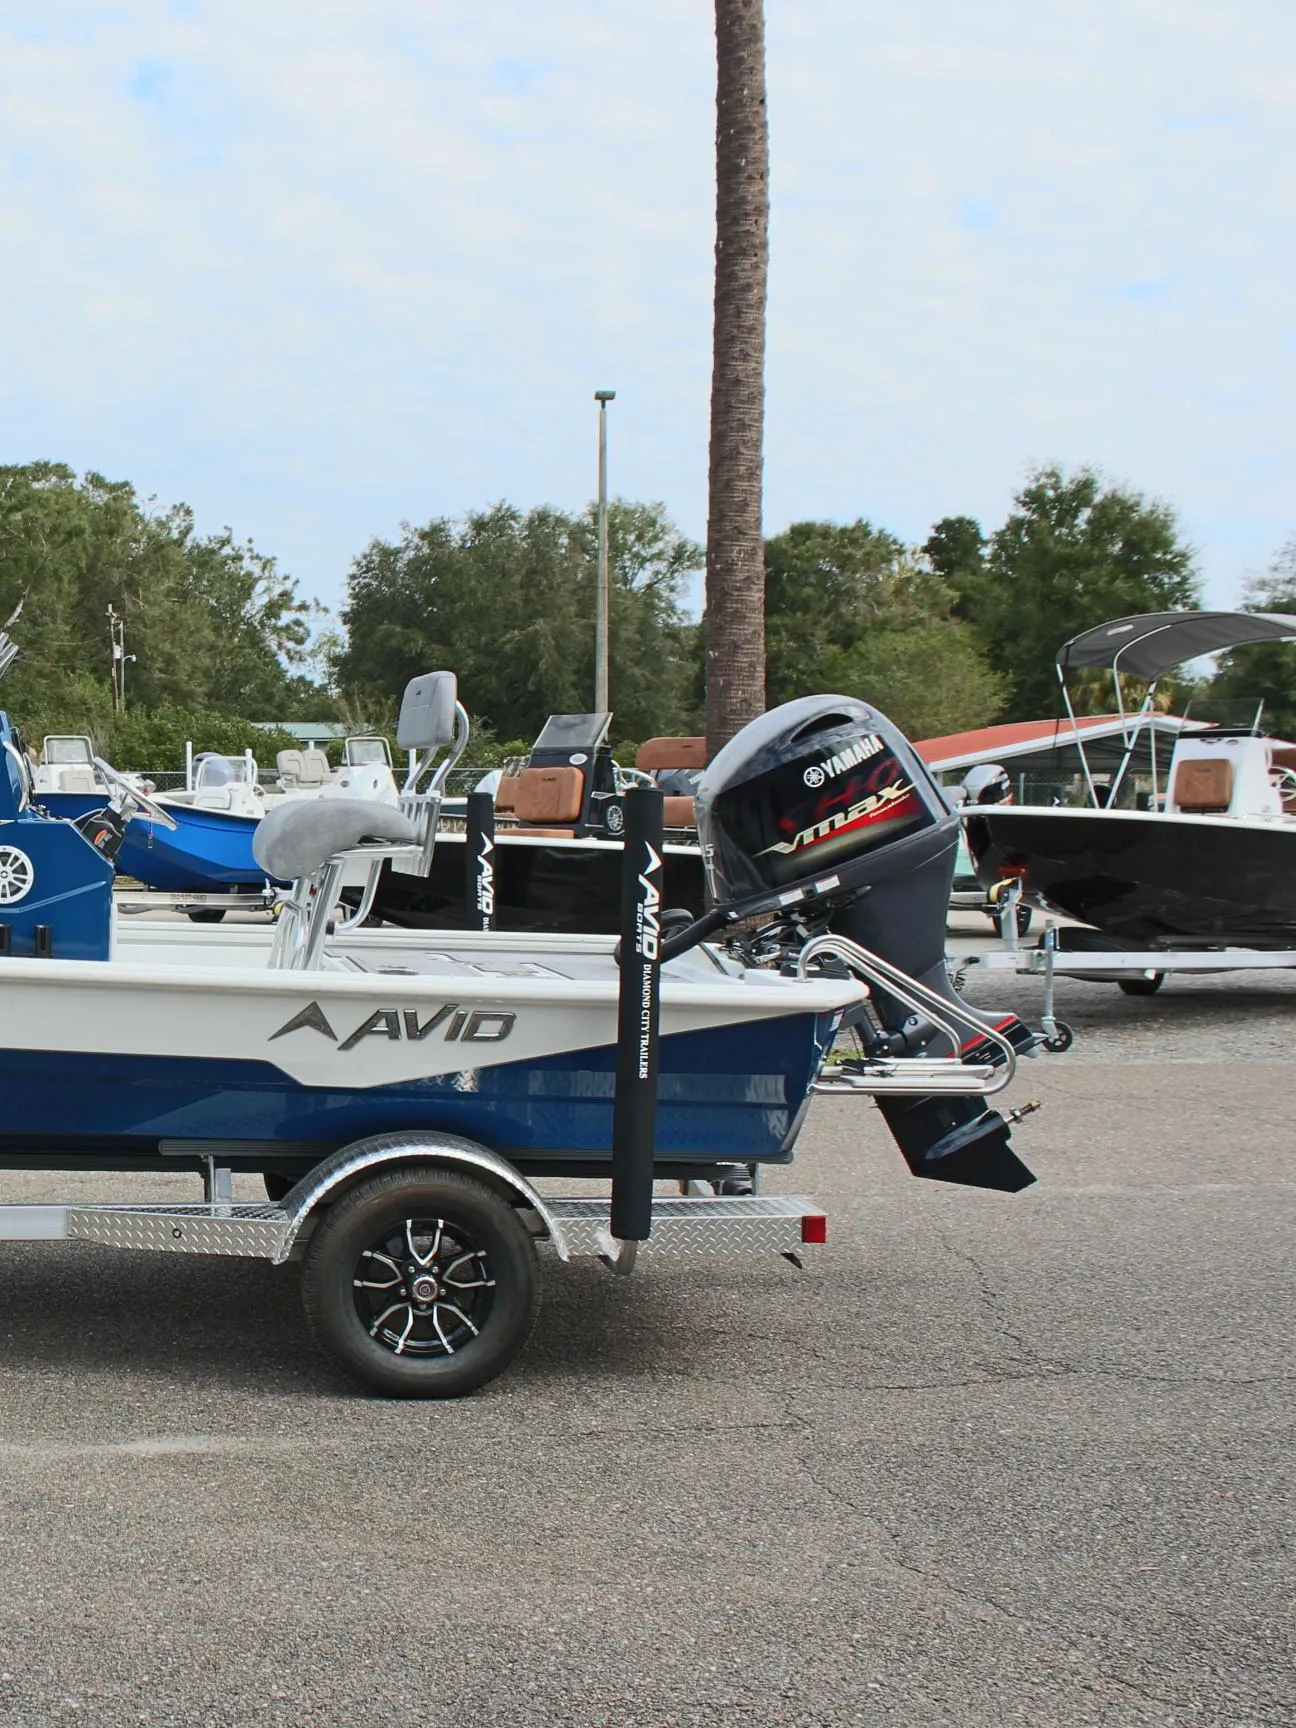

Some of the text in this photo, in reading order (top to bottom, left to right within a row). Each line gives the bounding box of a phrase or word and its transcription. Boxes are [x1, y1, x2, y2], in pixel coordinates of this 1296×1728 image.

[820, 733, 885, 779] YAMAHA
[477, 854, 495, 915] AVID
[635, 901, 644, 954] BOATS
[638, 873, 661, 961] AVID
[336, 1003, 518, 1051] AVID
[638, 963, 653, 1080] DIAMOND CITY TRAILERS
